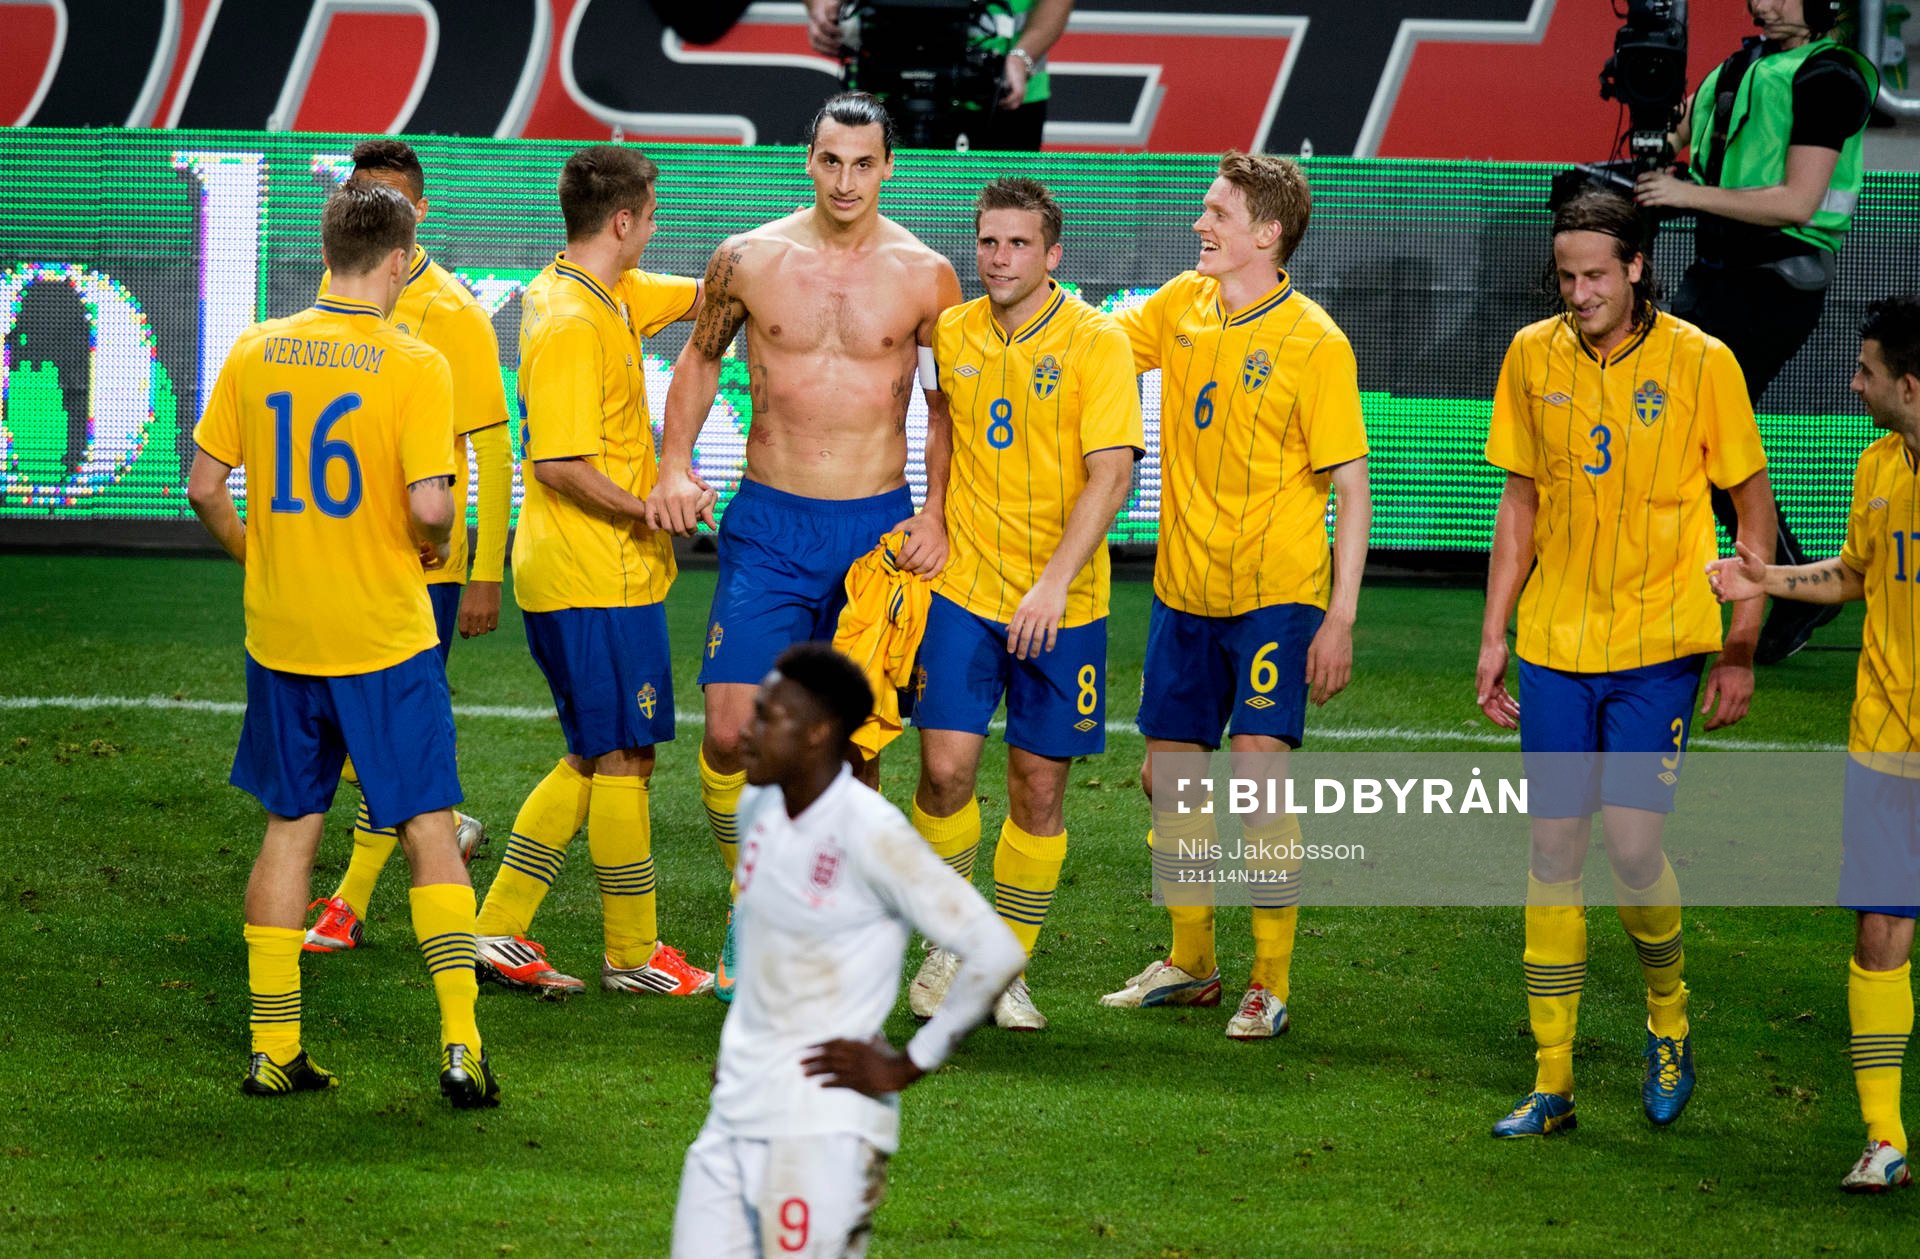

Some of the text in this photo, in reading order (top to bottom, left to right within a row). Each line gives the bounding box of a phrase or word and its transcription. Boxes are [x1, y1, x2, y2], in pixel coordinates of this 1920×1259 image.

[263, 336, 386, 375] WERNBLOOM
[986, 398, 1015, 450] 8
[1194, 380, 1218, 430] 6
[265, 391, 363, 519] 16
[1583, 424, 1612, 475] 3
[1076, 663, 1098, 716] 8
[1250, 641, 1279, 694] 6
[1661, 717, 1684, 770] 3
[779, 1197, 809, 1253] 9
